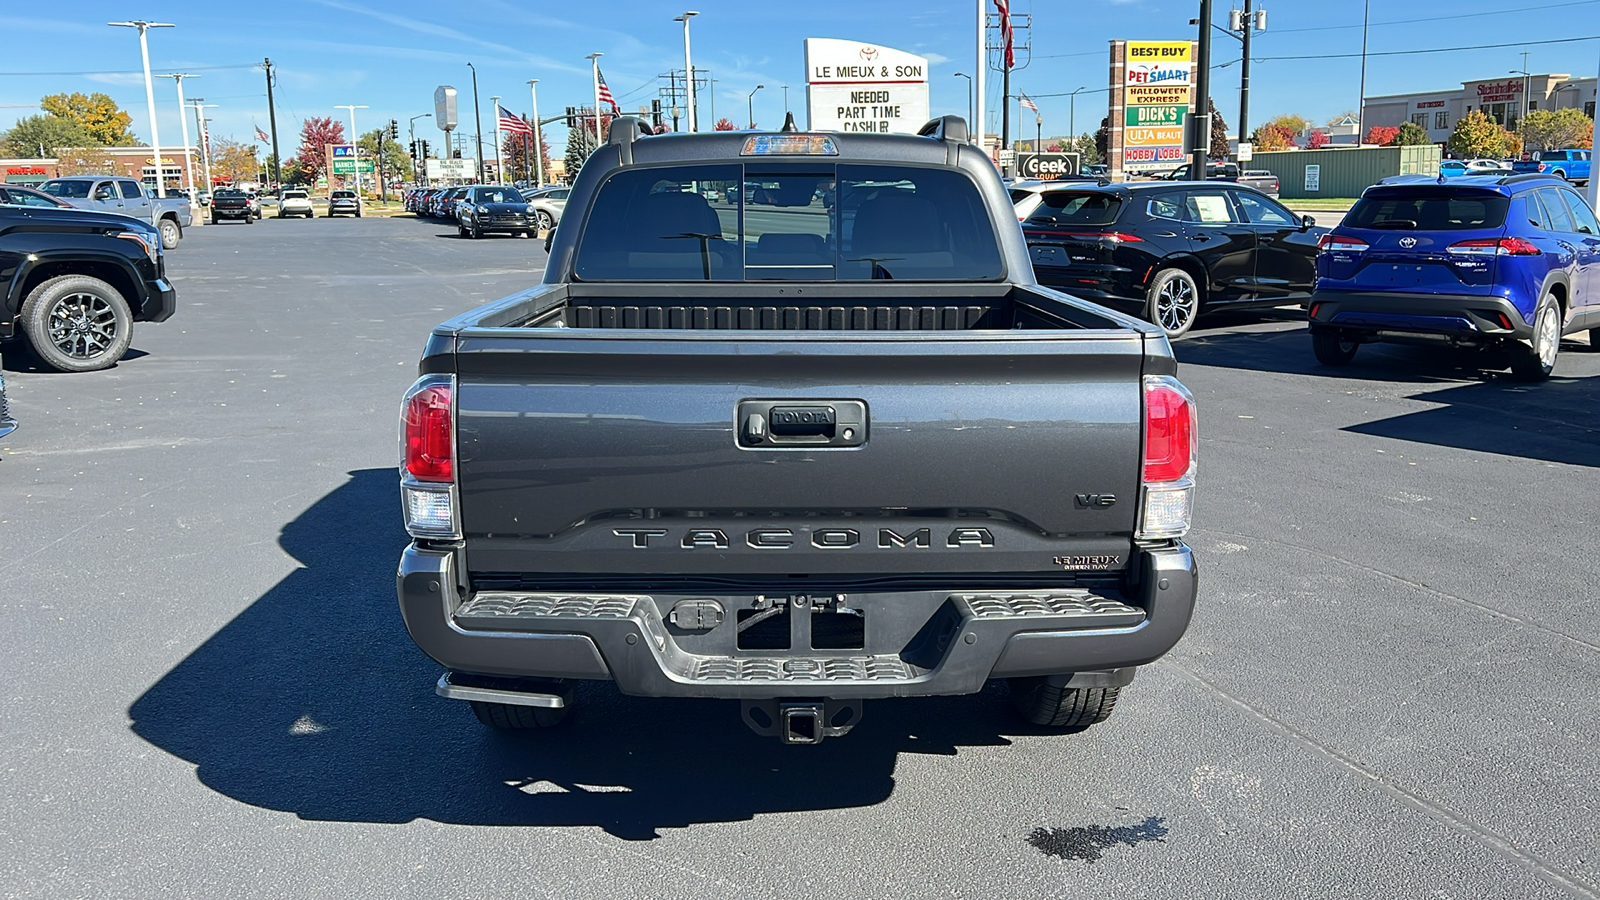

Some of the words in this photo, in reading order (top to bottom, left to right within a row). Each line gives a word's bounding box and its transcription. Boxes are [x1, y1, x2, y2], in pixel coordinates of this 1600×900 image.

[1131, 47, 1160, 56] BEST
[1162, 47, 1186, 56] BUY
[816, 66, 831, 78] LE
[836, 66, 875, 78] MIEUX
[881, 66, 889, 77] &
[895, 65, 922, 77] SON
[851, 91, 890, 104] NEEDED
[837, 106, 867, 119] PART
[872, 106, 901, 118] TIME
[1138, 107, 1178, 122] DICK'S
[1130, 130, 1155, 140] ULTA
[1157, 131, 1182, 140] BEAUT
[1125, 149, 1156, 160] HOBBY
[1028, 158, 1067, 173] Geek
[775, 412, 831, 423] TOYOTA
[1075, 494, 1116, 507] V6
[612, 527, 995, 549] TACOMA
[1053, 555, 1071, 565] LE
[1074, 555, 1120, 564] MIEUX
